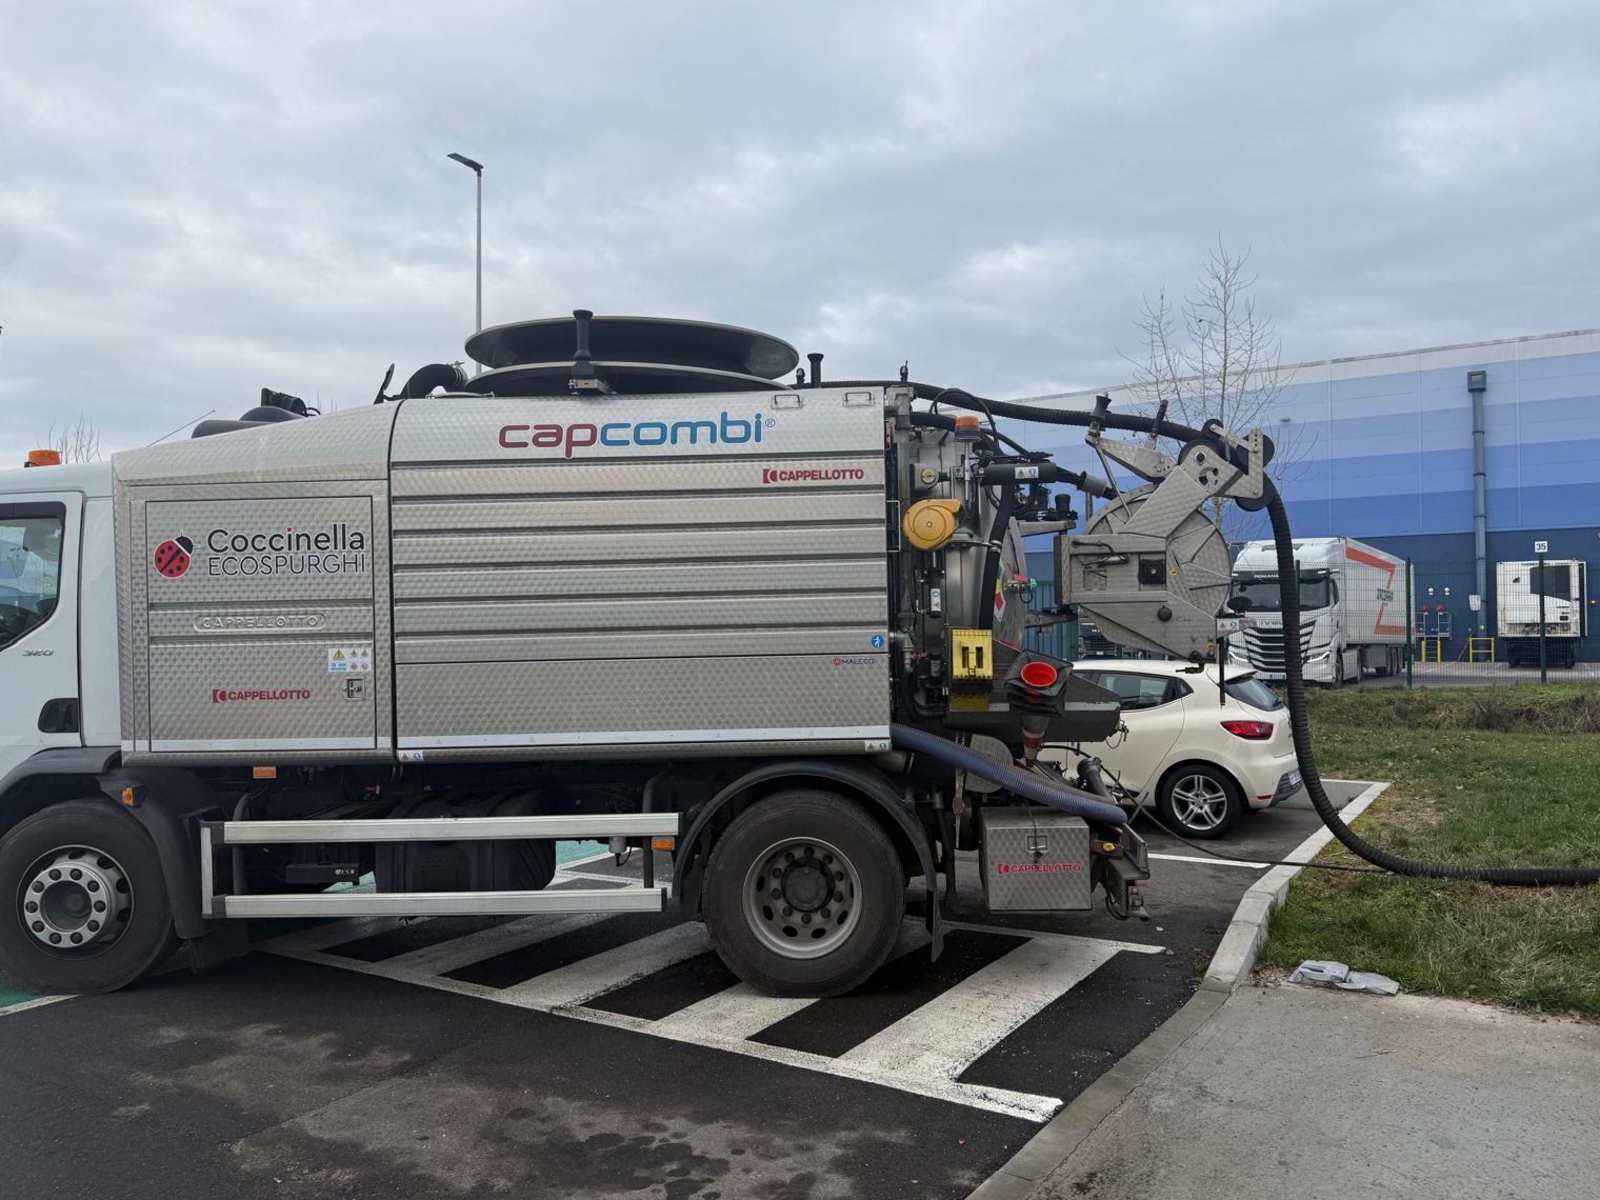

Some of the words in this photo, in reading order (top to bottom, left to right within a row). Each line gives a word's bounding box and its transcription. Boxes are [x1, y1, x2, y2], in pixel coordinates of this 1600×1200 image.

[779, 468, 865, 482] CAPPELLOTTO
[207, 523, 365, 552] Coccinella
[1536, 542, 1547, 551] 35
[208, 554, 365, 576] ECOSPURGHI
[202, 614, 319, 629] CAPPELLOTTO
[228, 689, 311, 701] CAPPELLOTTO
[1011, 863, 1082, 873] CAPPELLOTTO
